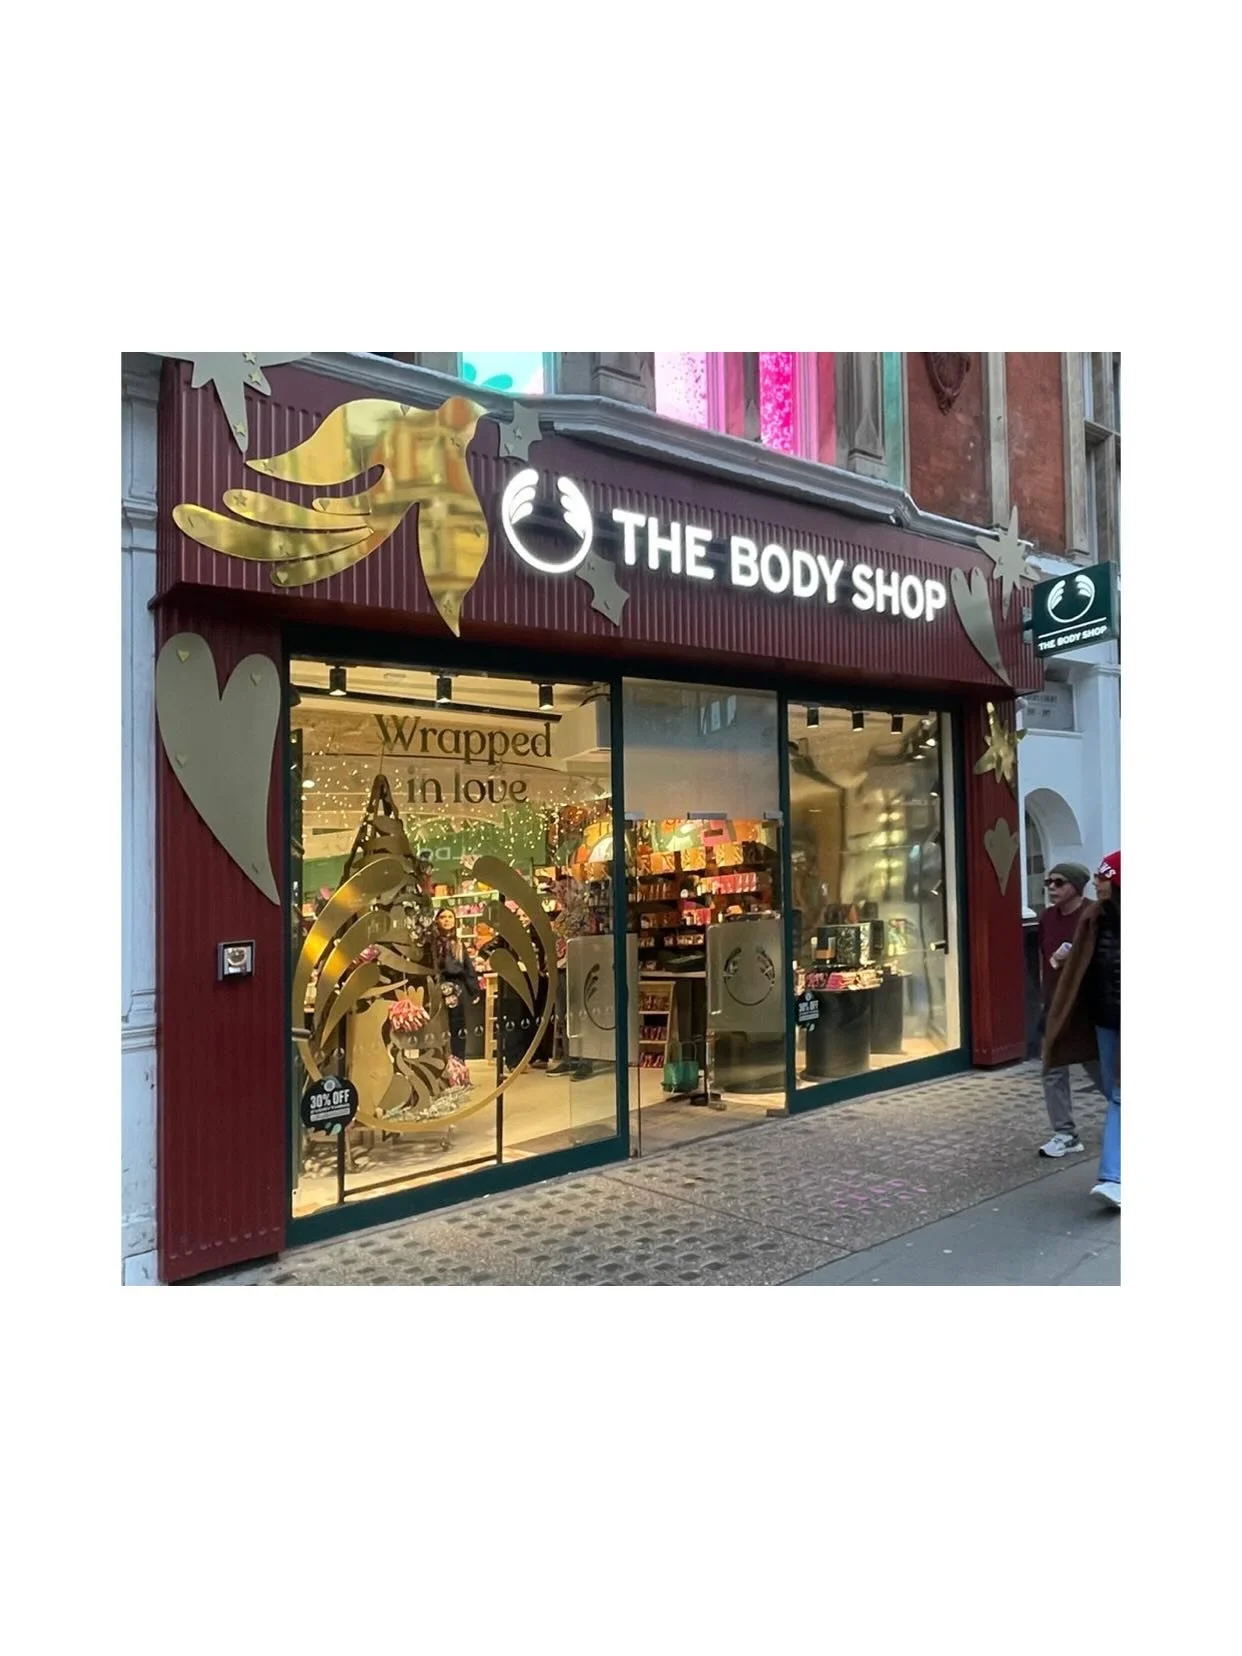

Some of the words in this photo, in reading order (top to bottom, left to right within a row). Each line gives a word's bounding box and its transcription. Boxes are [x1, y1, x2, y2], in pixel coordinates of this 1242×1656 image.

[612, 508, 715, 581] THE
[730, 535, 845, 604] BODY
[851, 563, 947, 622] SHOP
[1038, 639, 1056, 651] THE
[1057, 632, 1081, 646] BODY
[1082, 625, 1108, 639] SHOP
[374, 713, 552, 766] Wrapped
[407, 764, 443, 804] in
[453, 765, 528, 804] love
[310, 1093, 332, 1110] 30%
[332, 1089, 350, 1105] OFF
